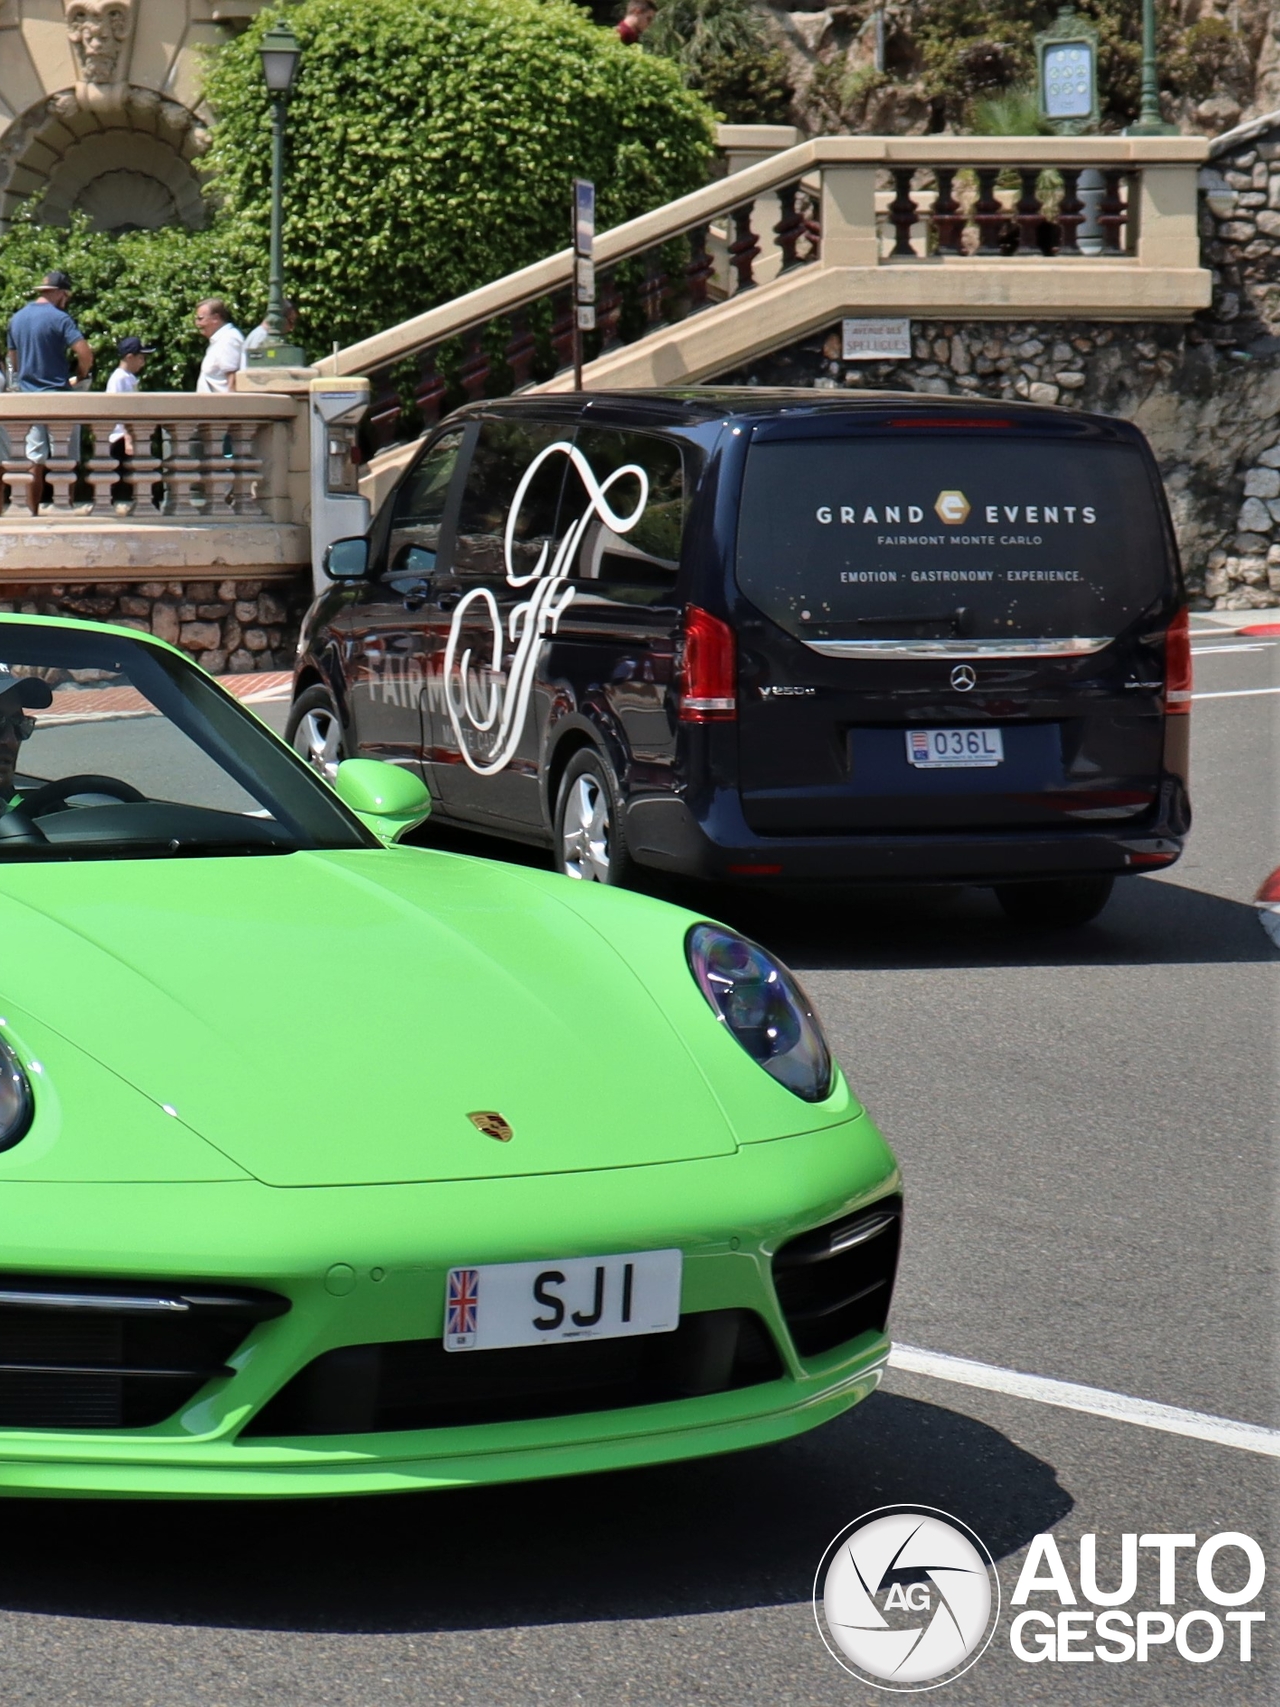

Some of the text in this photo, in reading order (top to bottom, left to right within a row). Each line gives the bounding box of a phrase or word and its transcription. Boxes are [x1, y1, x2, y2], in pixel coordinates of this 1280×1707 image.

[816, 506, 924, 524] GRAND
[986, 506, 1097, 524] EVENTS
[877, 535, 1043, 545] FAIRMONT MONTE CARLO
[840, 571, 897, 583] EMOTION
[911, 571, 994, 582] GASTRONOMY
[934, 731, 996, 755] 036L
